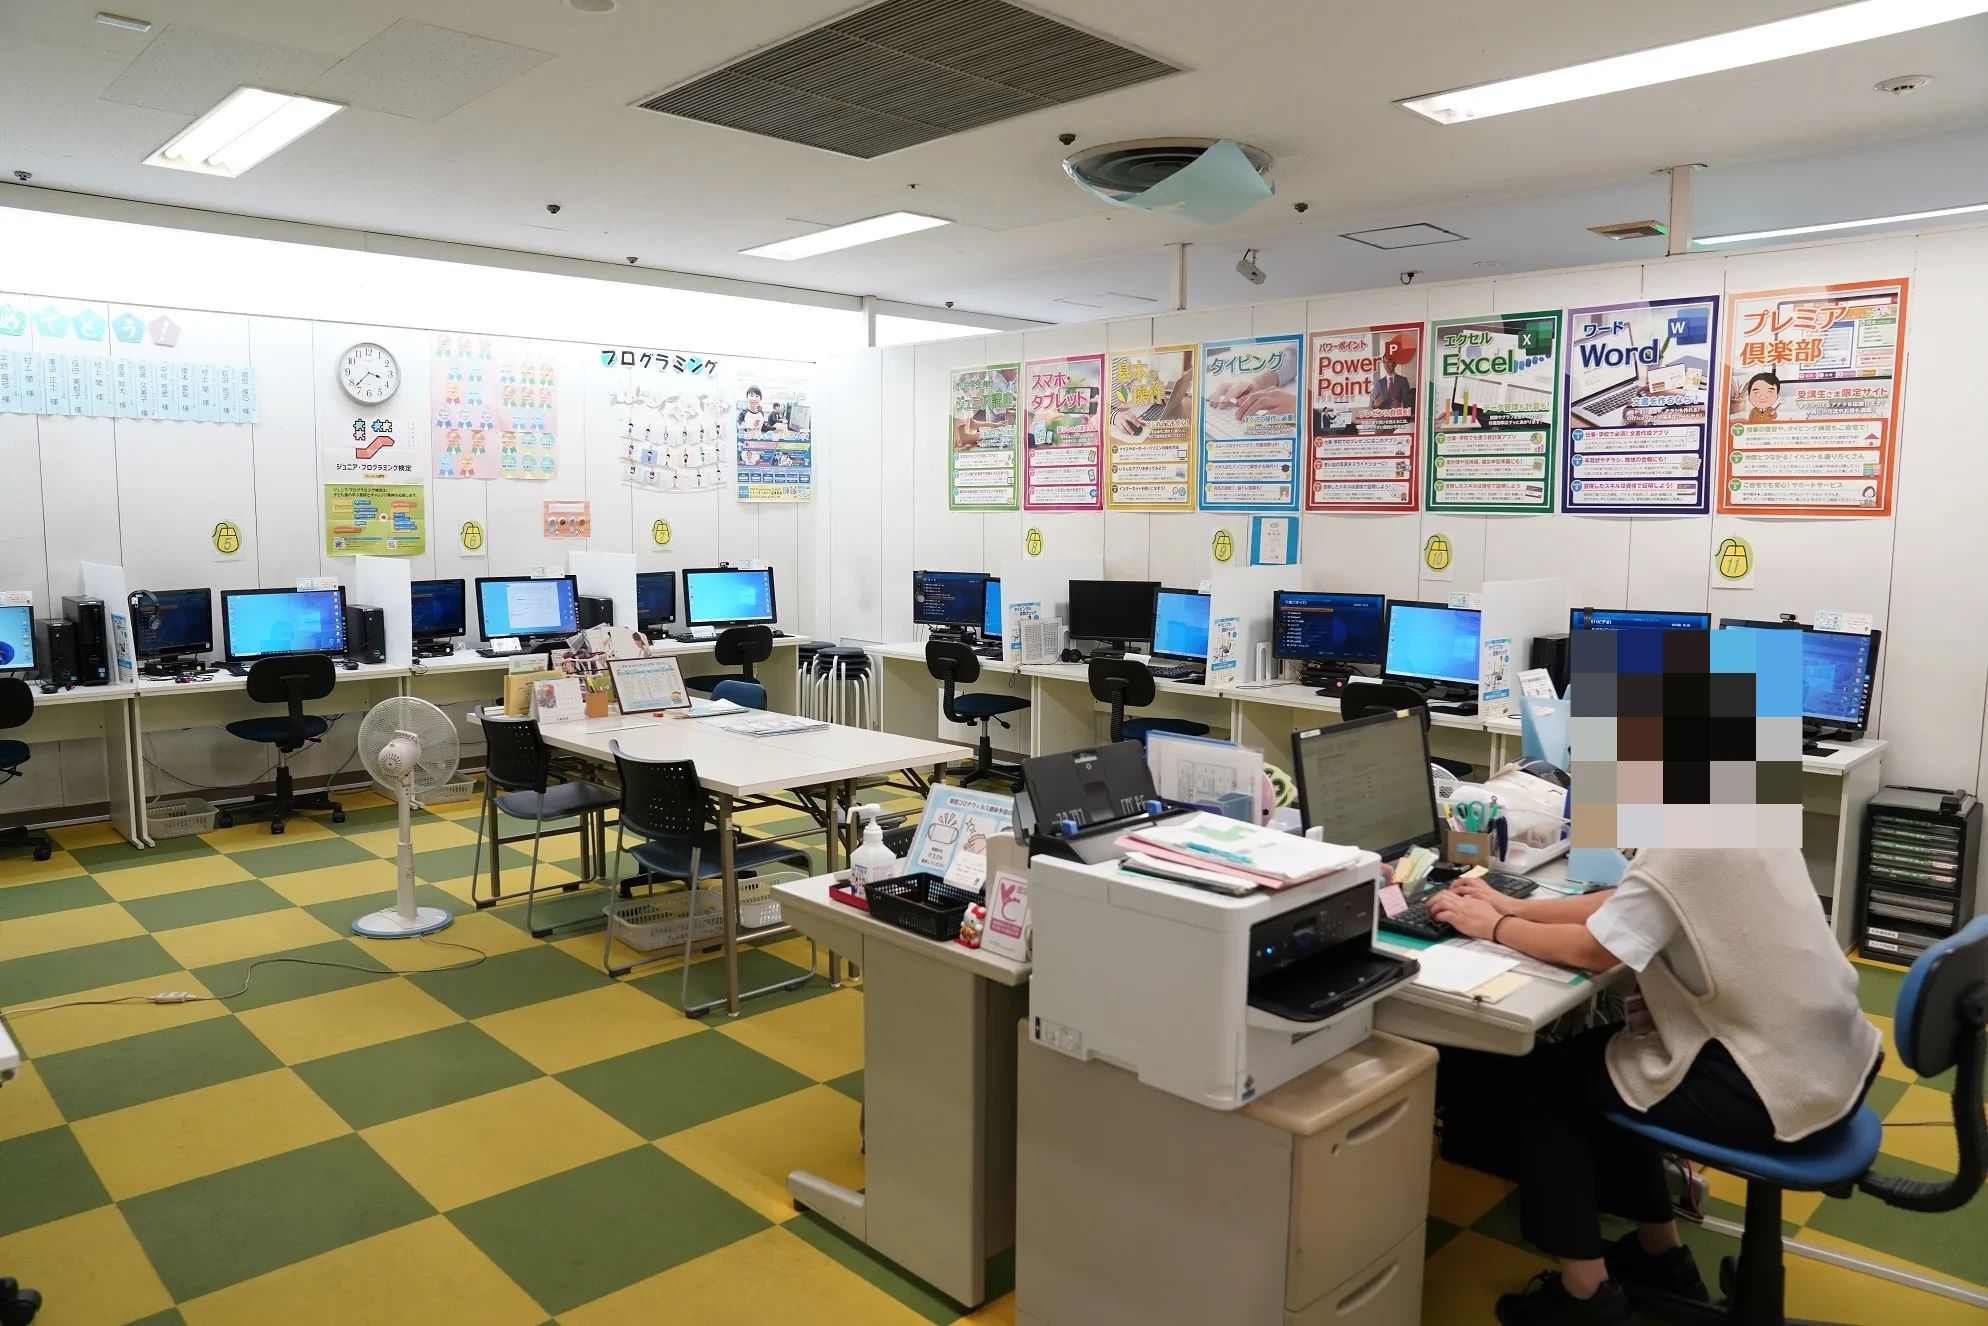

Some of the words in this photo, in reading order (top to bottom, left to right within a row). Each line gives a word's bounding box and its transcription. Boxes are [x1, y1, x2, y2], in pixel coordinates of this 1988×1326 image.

[1743, 305, 1850, 336] プレミア
[1583, 320, 1625, 338] ワード
[1670, 321, 1686, 334] W
[1444, 331, 1493, 347] エクセル
[1522, 333, 1532, 346] X
[365, 348, 373, 356] 12
[1318, 339, 1368, 353] パワーポイント
[1389, 343, 1398, 355] P
[1740, 338, 1823, 367] 倶楽部
[355, 350, 362, 358] 11
[377, 351, 381, 359] 1
[1579, 338, 1660, 369] Word
[348, 357, 356, 366] 10
[385, 360, 390, 368] 2
[601, 350, 718, 375] プログラミング
[1210, 351, 1284, 375] タイピング
[1318, 356, 1383, 376] Power
[1442, 349, 1514, 377] Excel
[345, 368, 351, 376] 9
[388, 370, 393, 378] 3
[1116, 359, 1159, 382] 基本の
[357, 386, 362, 395] 7
[366, 389, 372, 397] 6
[377, 388, 383, 396] 5
[1317, 376, 1373, 397] Point
[1132, 382, 1166, 405] 操作
[1796, 387, 1889, 400] 受講生さま限定サイト
[1031, 391, 1087, 410] タブレット
[1483, 401, 1550, 413] データ管理も計算も！
[1630, 395, 1699, 408] 文書を作るなら！
[1585, 429, 1669, 438] 仕事・学校で必須！文書作成アプリ
[1746, 424, 1870, 434] 授業の復習や、タイピング練習もご自宅で！
[1446, 434, 1517, 442] 仕事・学校でも使う表計算アプリ
[1745, 453, 1866, 462] 仲間とつながる！イベントも盛りだくさん
[336, 463, 412, 472] ジュニア・プログラミング検定
[1583, 482, 1673, 490] 習得したスキルは資格で証明しよう！
[1743, 481, 1844, 490] ご自宅でも安心！サポートサービス
[224, 537, 232, 551] 5
[469, 534, 477, 547] 6
[659, 531, 666, 544] 7
[1031, 541, 1038, 555] 8
[1220, 543, 1227, 557] 9
[1433, 552, 1444, 567] 10
[1726, 557, 1741, 575] 11
